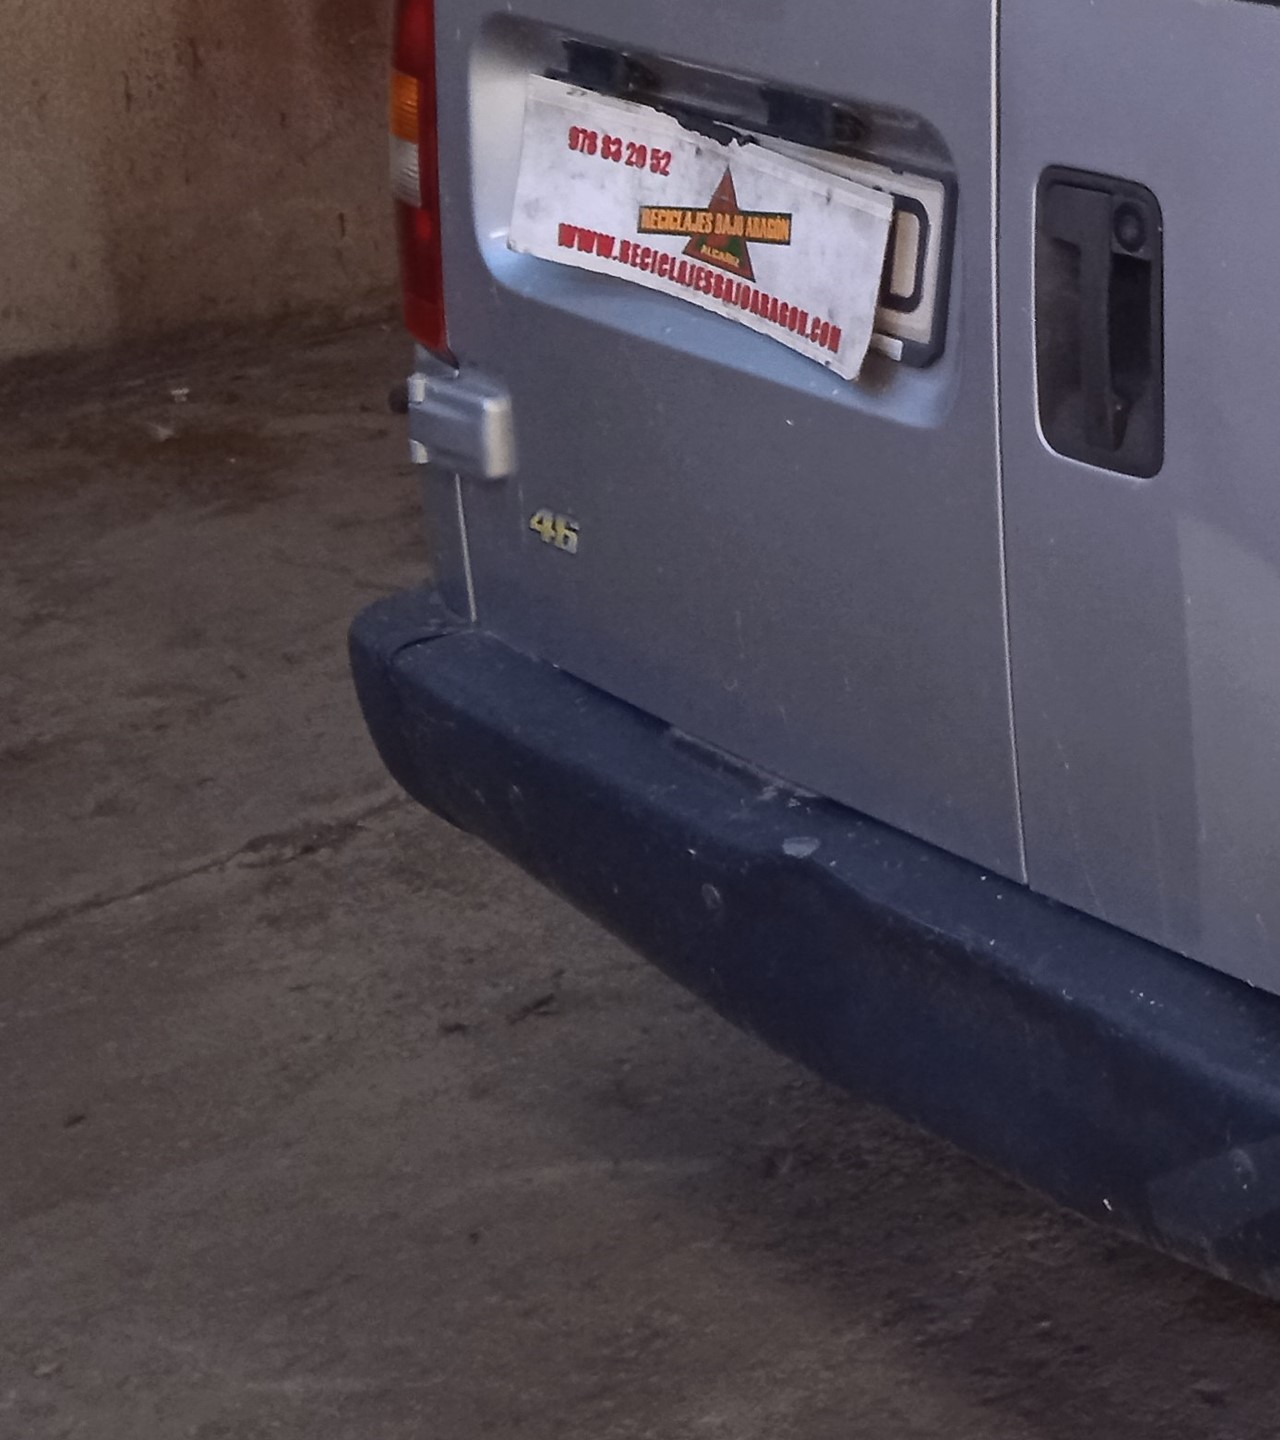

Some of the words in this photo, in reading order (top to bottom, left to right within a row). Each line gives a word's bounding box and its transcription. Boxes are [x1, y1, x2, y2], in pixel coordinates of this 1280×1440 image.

[568, 126, 598, 156] 978
[650, 148, 672, 177] 52
[641, 208, 713, 233] RECICLAJES
[558, 222, 842, 354] WWW.RECICLAJESBAJOARAGON.COM
[529, 508, 579, 554] 46
